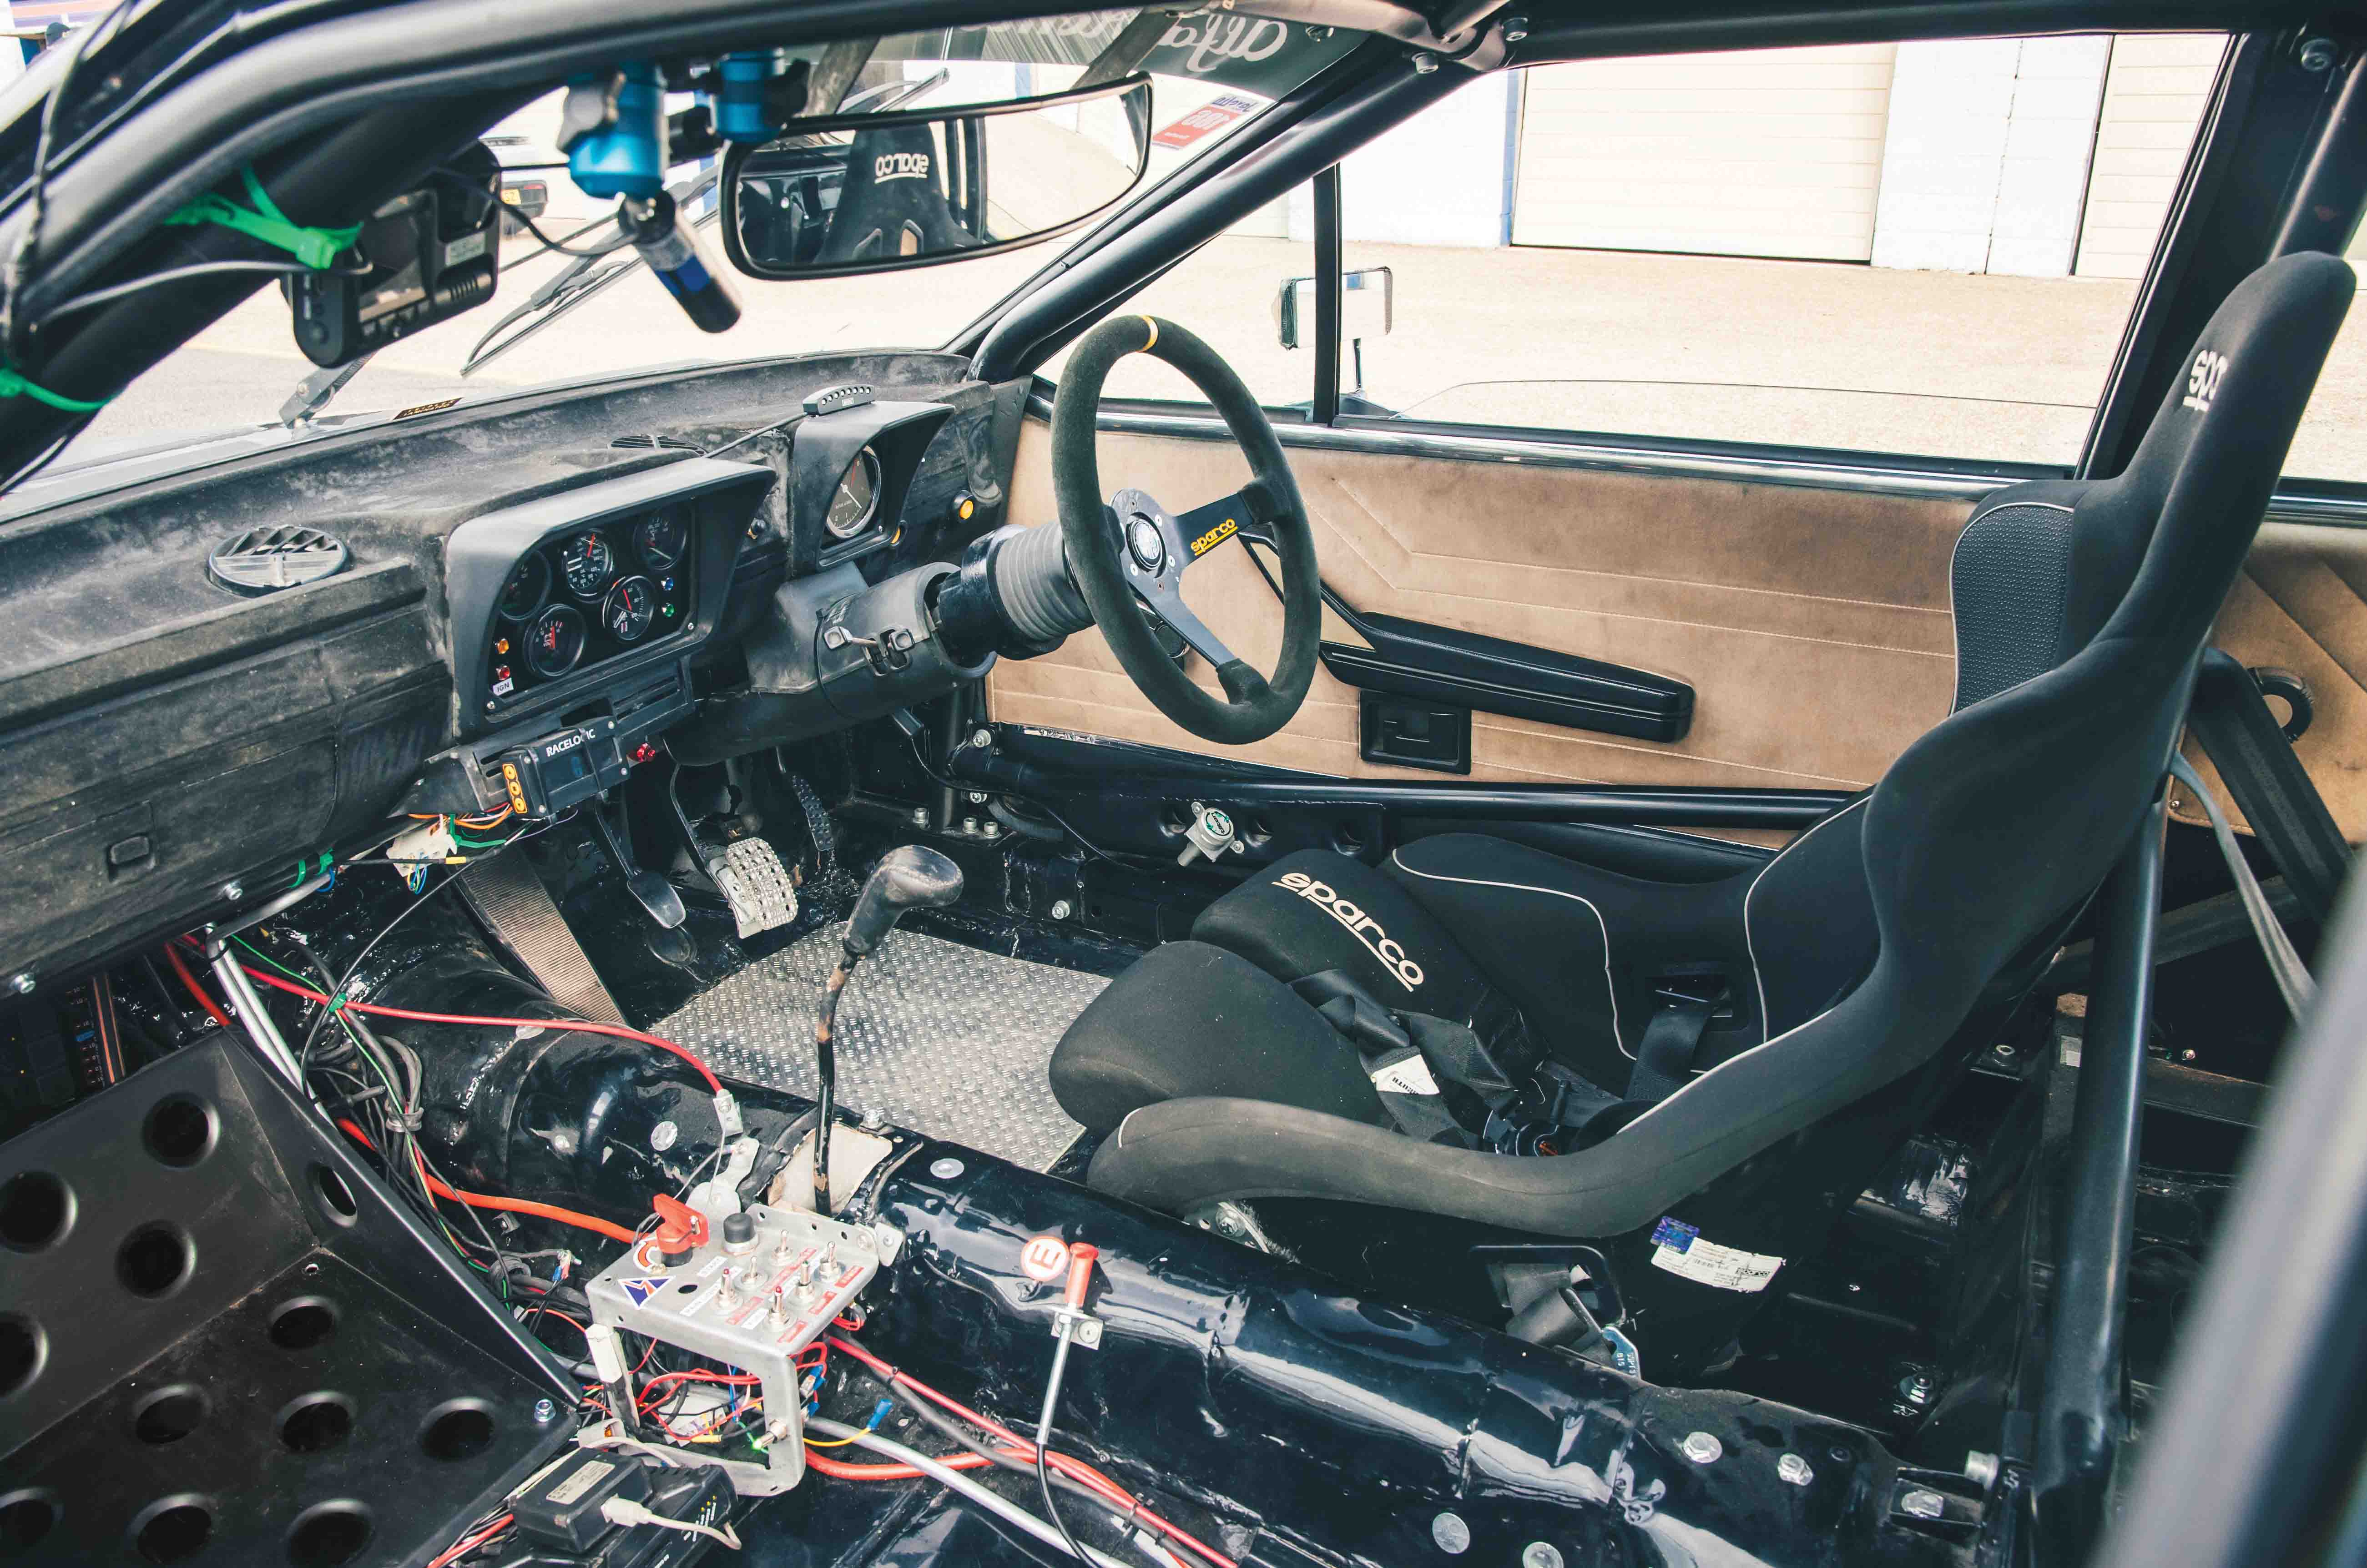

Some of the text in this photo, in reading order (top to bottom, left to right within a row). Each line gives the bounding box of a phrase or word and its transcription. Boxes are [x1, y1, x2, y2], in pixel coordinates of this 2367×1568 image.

[1190, 519, 1236, 554] sparco
[497, 681, 510, 693] IGN
[1277, 872, 1424, 985] sparco
[1029, 1244, 1061, 1271] E
